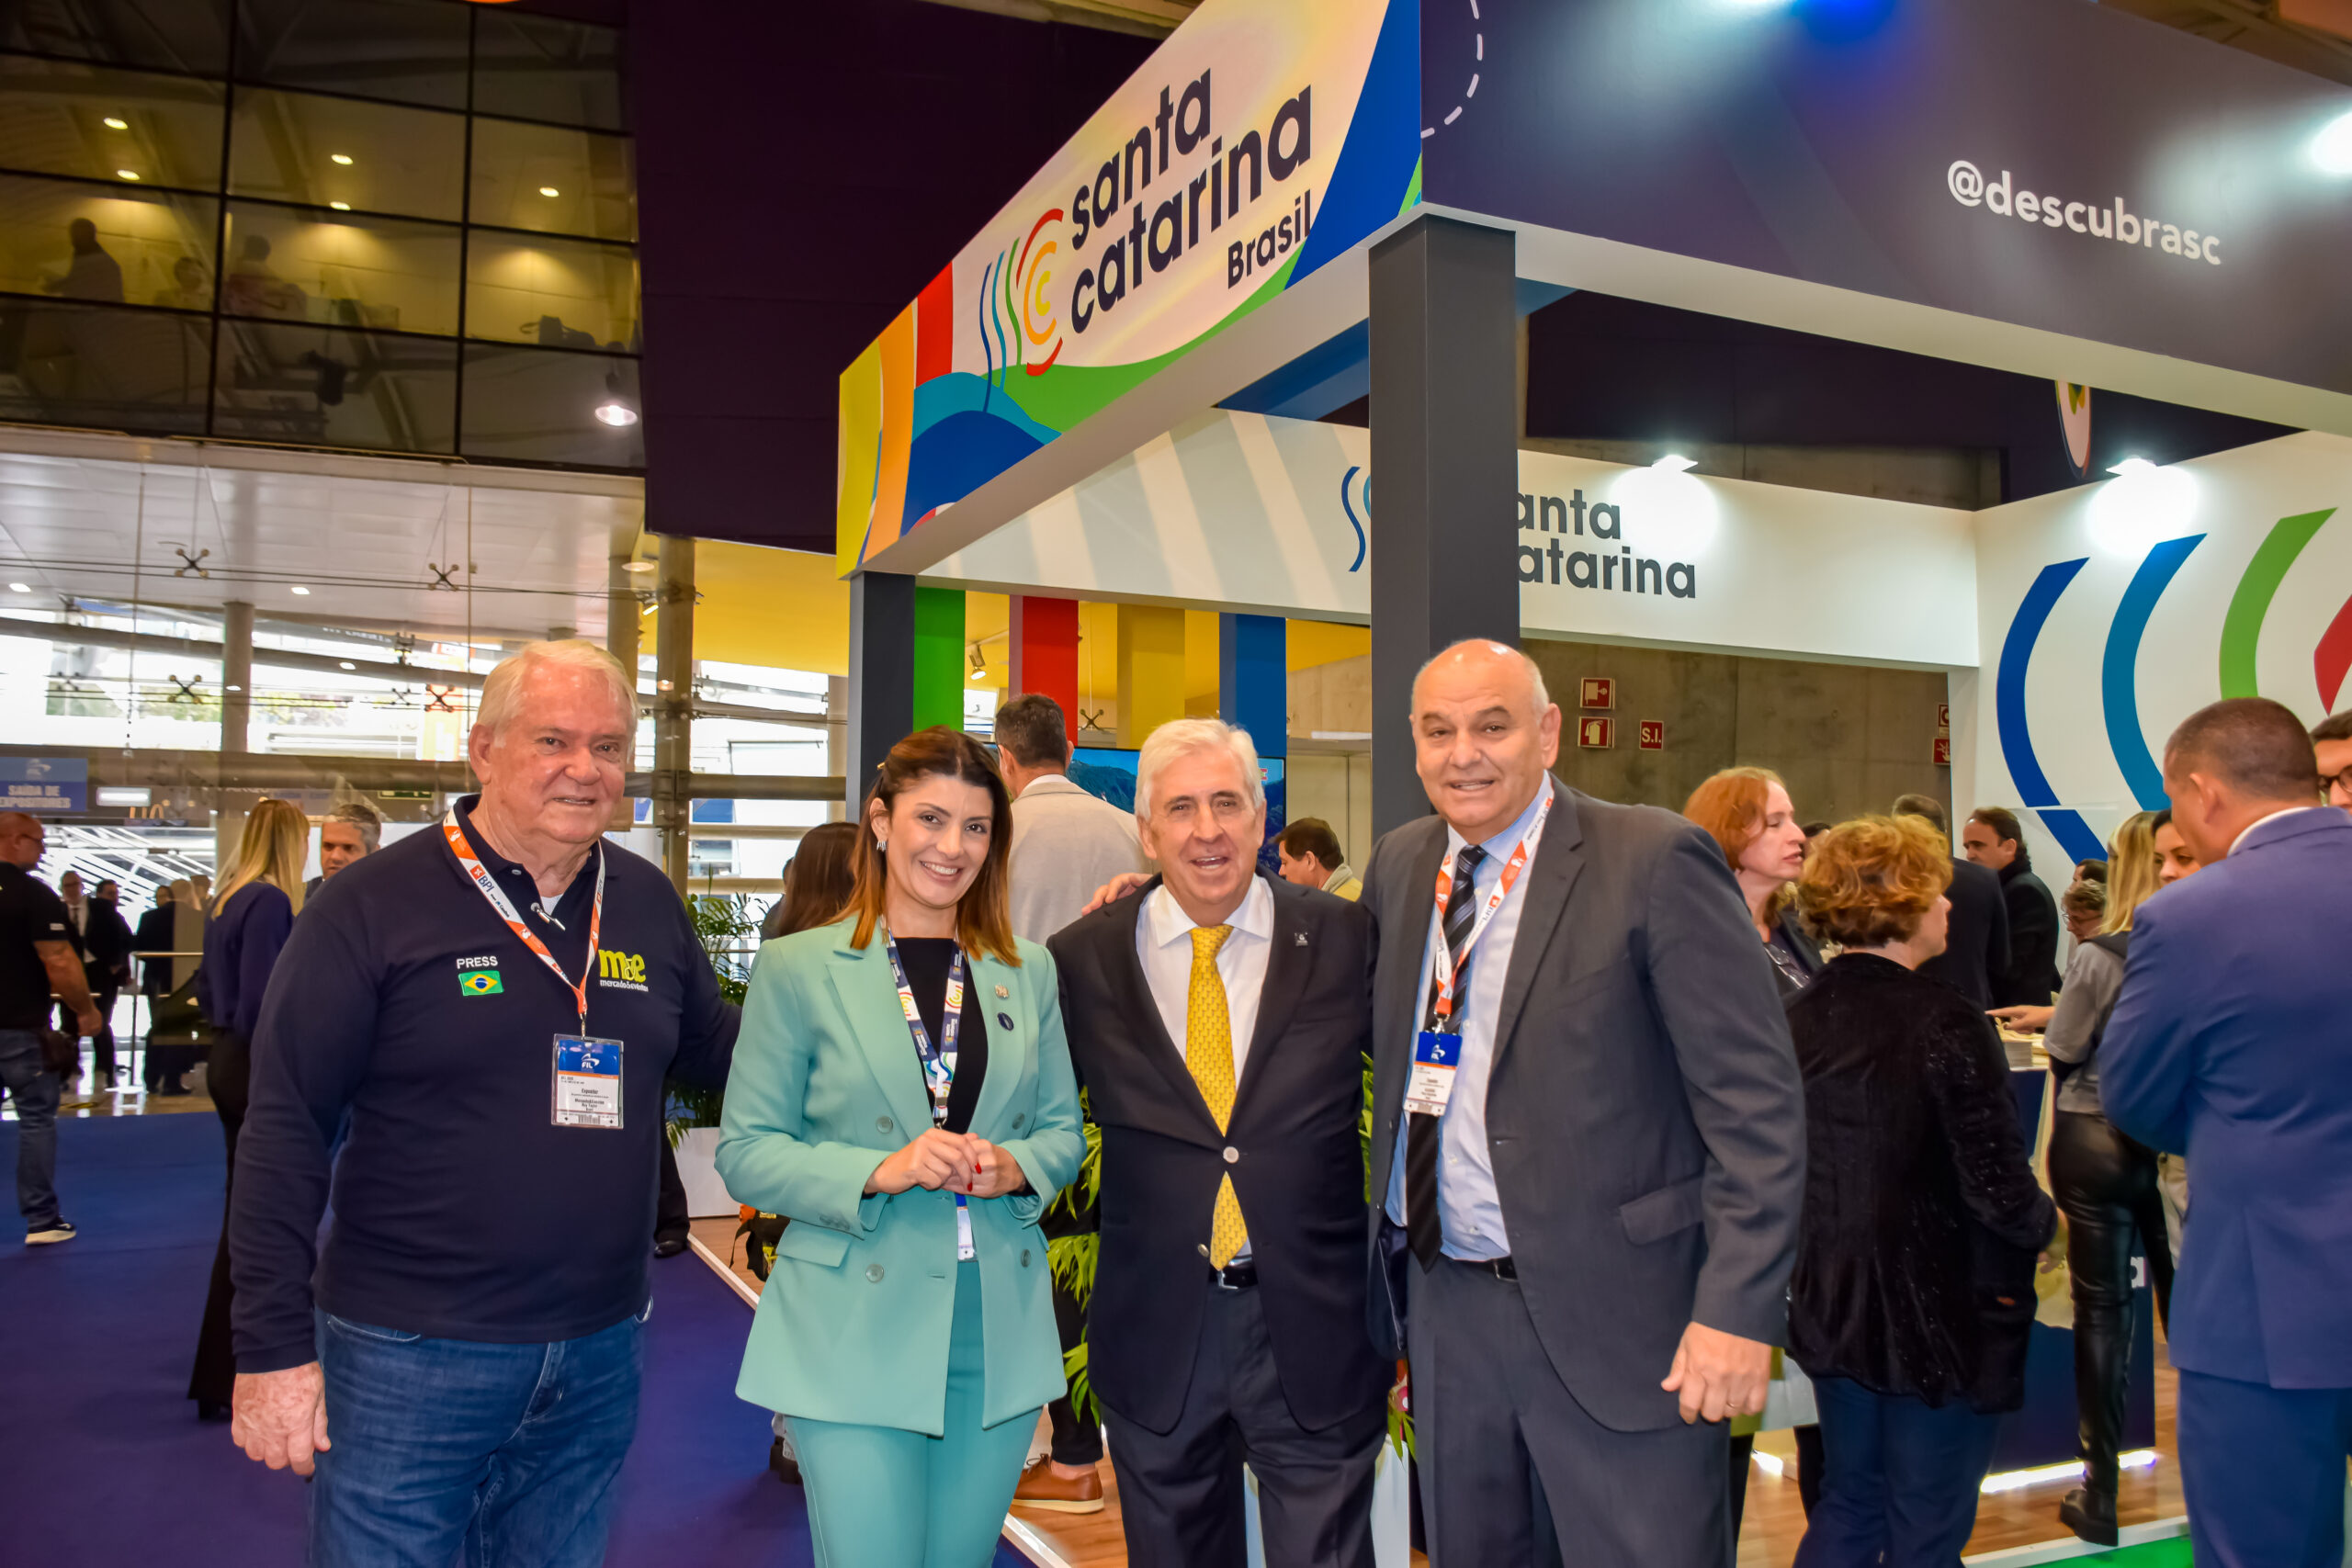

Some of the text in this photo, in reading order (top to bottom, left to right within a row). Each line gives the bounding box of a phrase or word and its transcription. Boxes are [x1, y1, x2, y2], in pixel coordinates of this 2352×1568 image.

[1071, 67, 1211, 251] santa
[1070, 84, 1312, 334] catarina
[1227, 188, 1311, 290] Brasil
[1947, 159, 2222, 265] @descubrasc
[1518, 488, 1621, 540] anta
[1519, 537, 1696, 599] atarina
[1641, 727, 1662, 743] S.I.
[478, 875, 494, 892] BPI
[456, 955, 499, 970] PRESS
